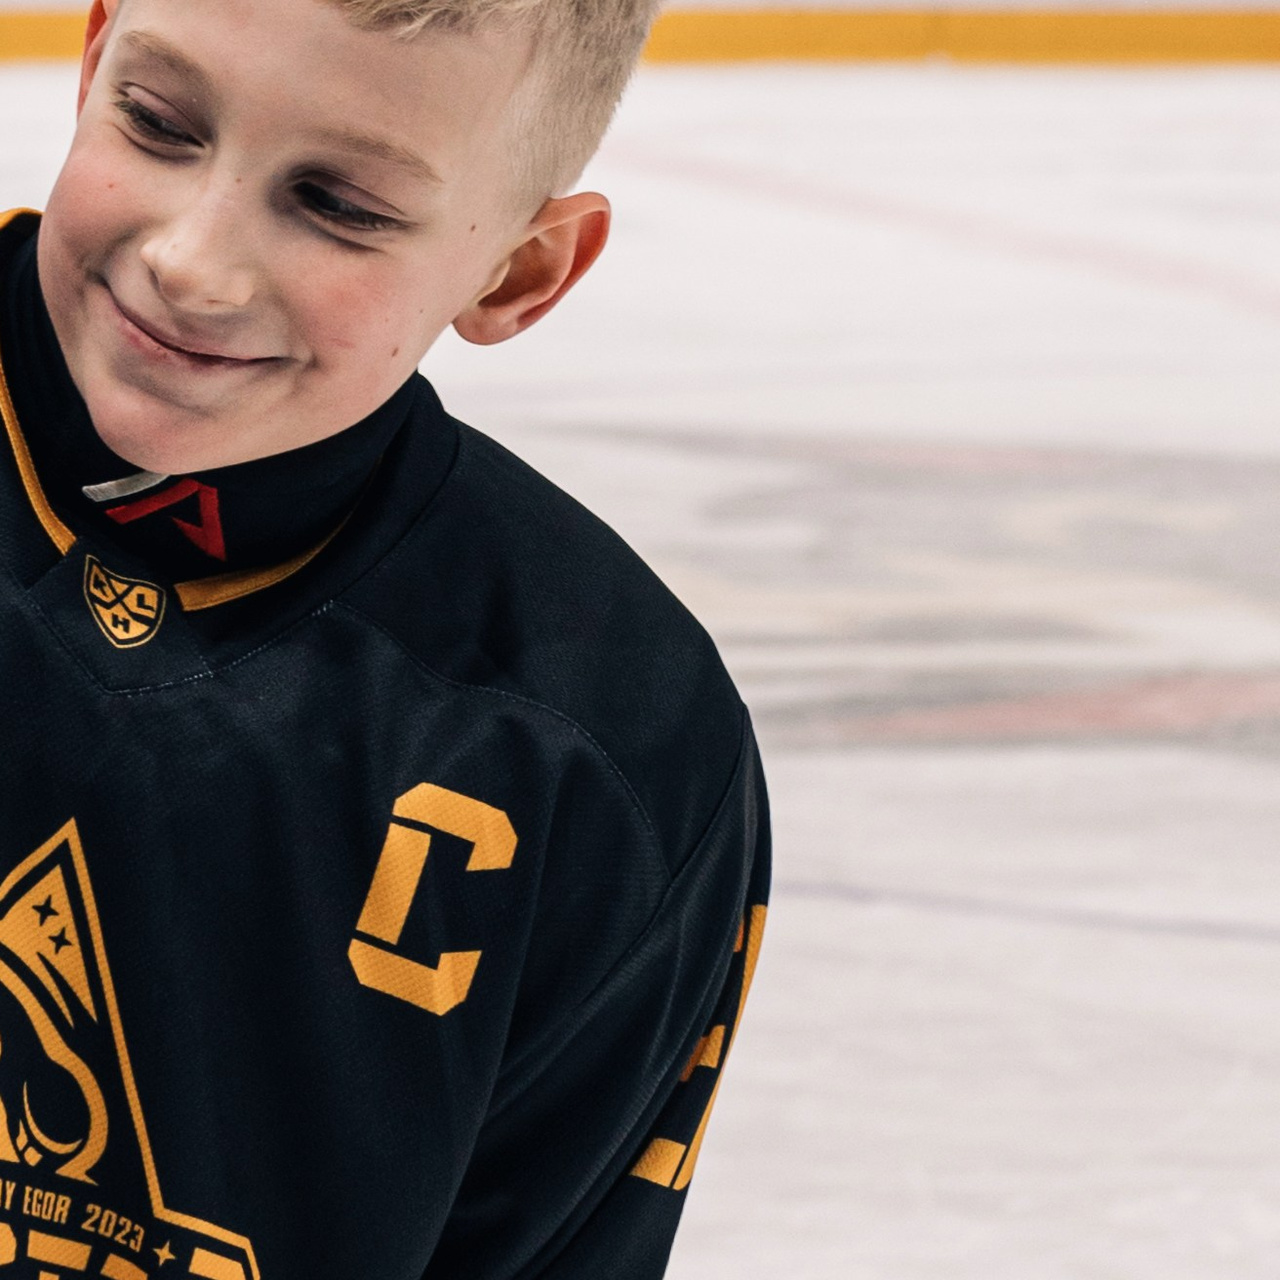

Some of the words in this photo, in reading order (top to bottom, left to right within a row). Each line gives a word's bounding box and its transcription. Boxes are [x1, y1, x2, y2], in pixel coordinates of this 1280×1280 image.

[347, 781, 518, 1016] C
[23, 1185, 72, 1224] EGOR
[81, 1203, 146, 1253] 2023
